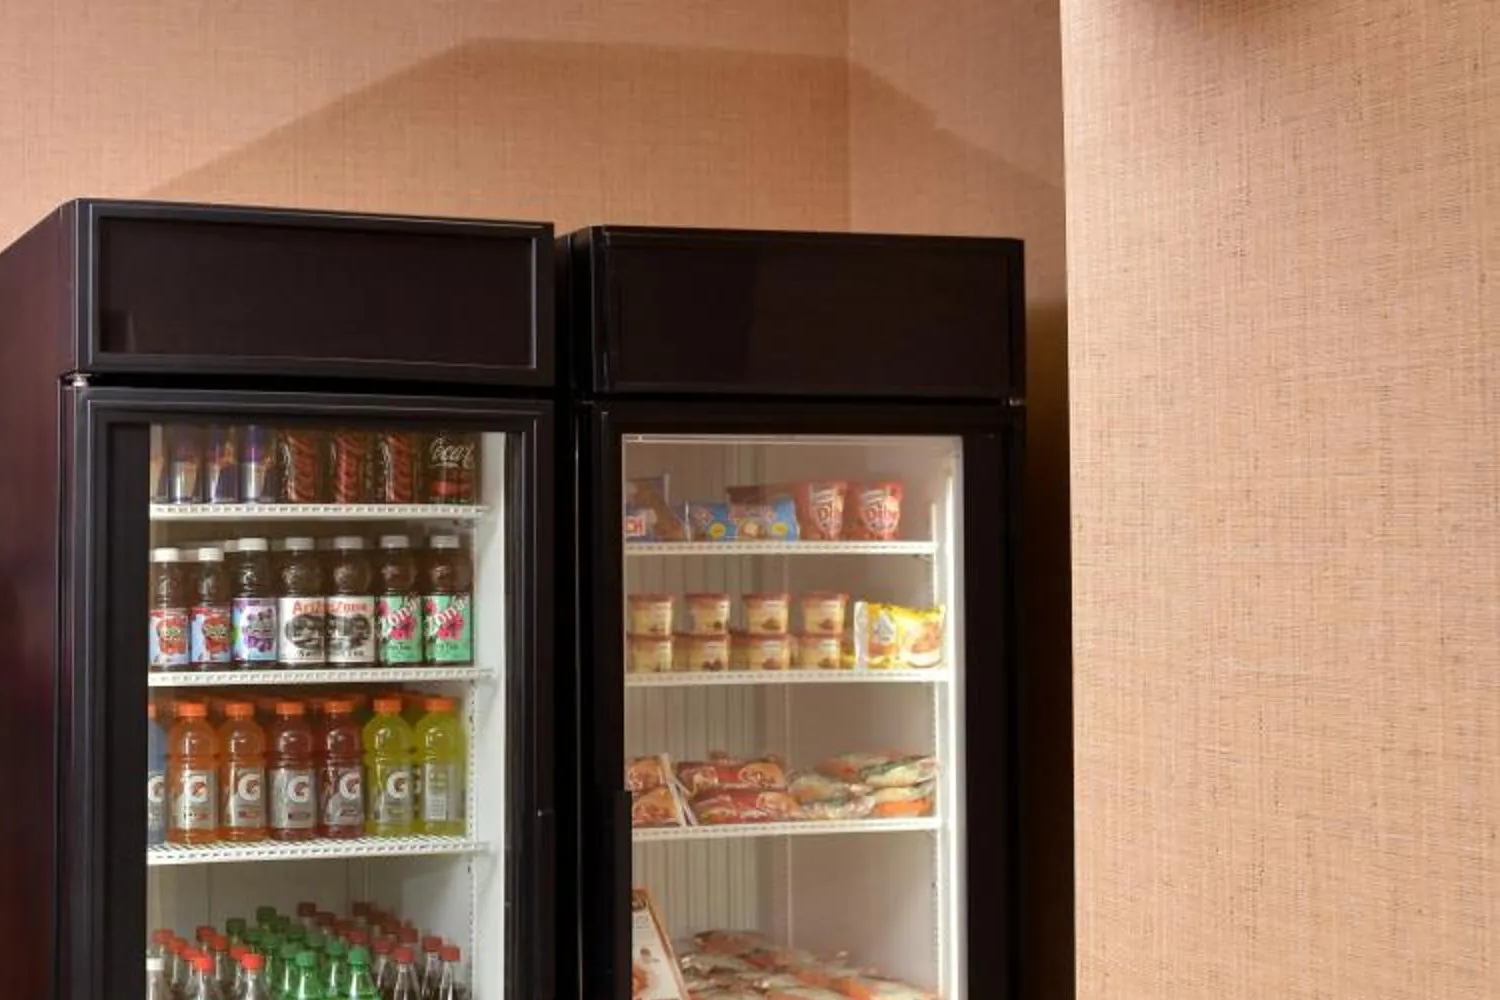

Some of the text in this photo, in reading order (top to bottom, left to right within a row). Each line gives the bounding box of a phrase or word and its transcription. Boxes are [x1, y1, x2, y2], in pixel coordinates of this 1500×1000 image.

[184, 774, 208, 802] G
[238, 773, 260, 801] G
[287, 775, 310, 802] G
[339, 772, 361, 800] G
[386, 771, 409, 799] G
